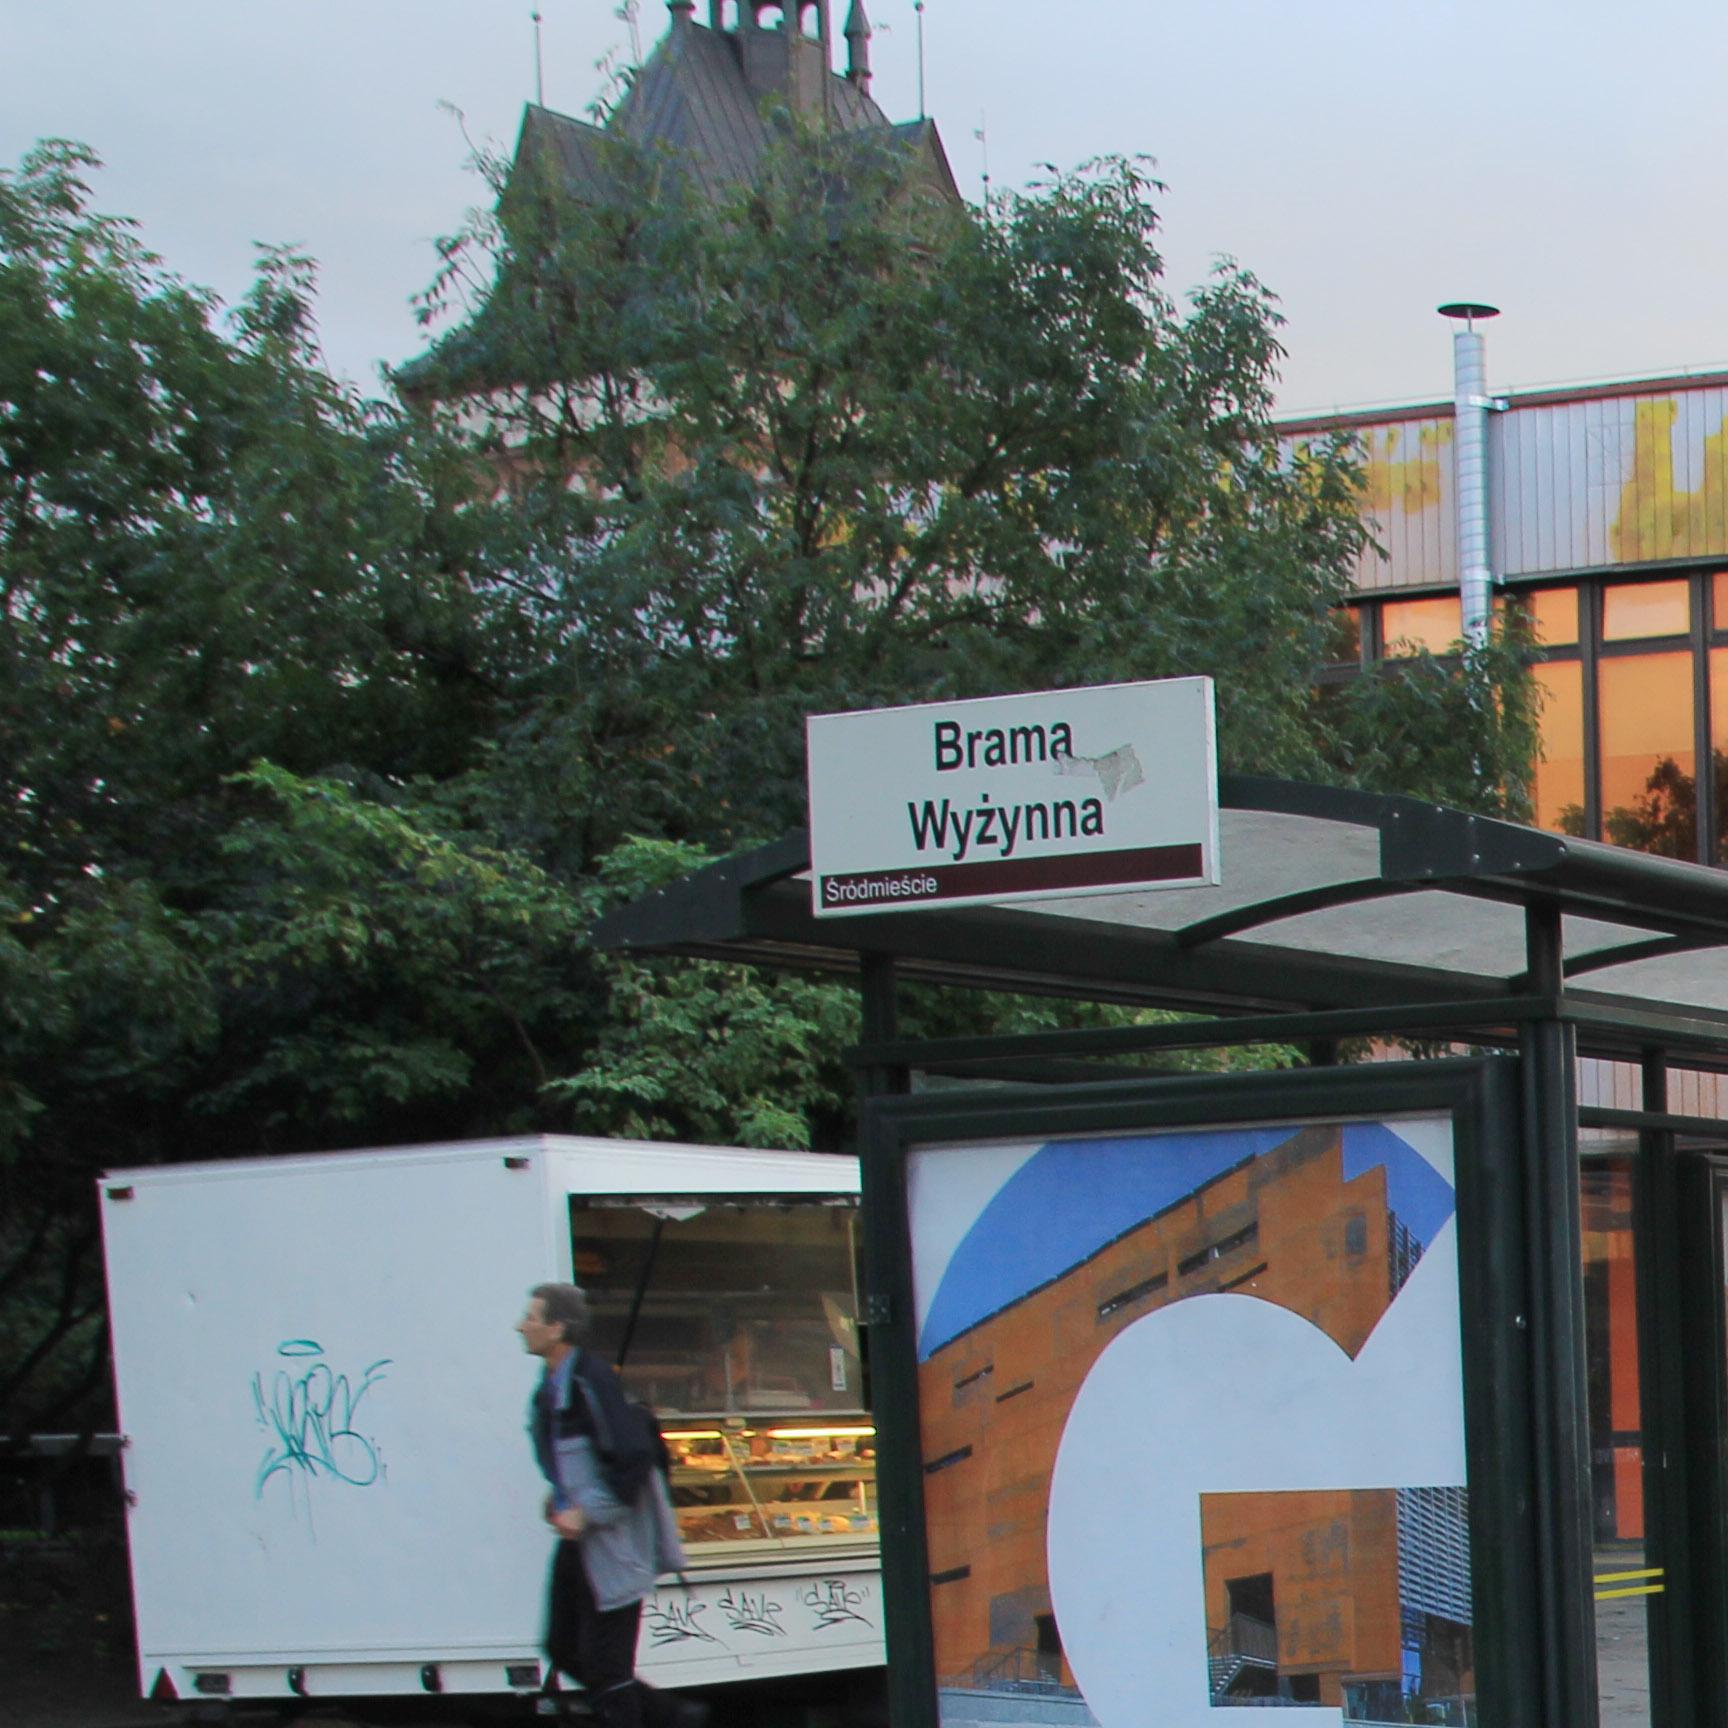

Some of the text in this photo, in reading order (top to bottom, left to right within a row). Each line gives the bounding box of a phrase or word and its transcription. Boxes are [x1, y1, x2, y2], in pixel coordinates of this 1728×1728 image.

[935, 721, 1072, 771] Brama
[908, 794, 1104, 860] Wyżynna
[826, 874, 938, 902] Śródmieście
